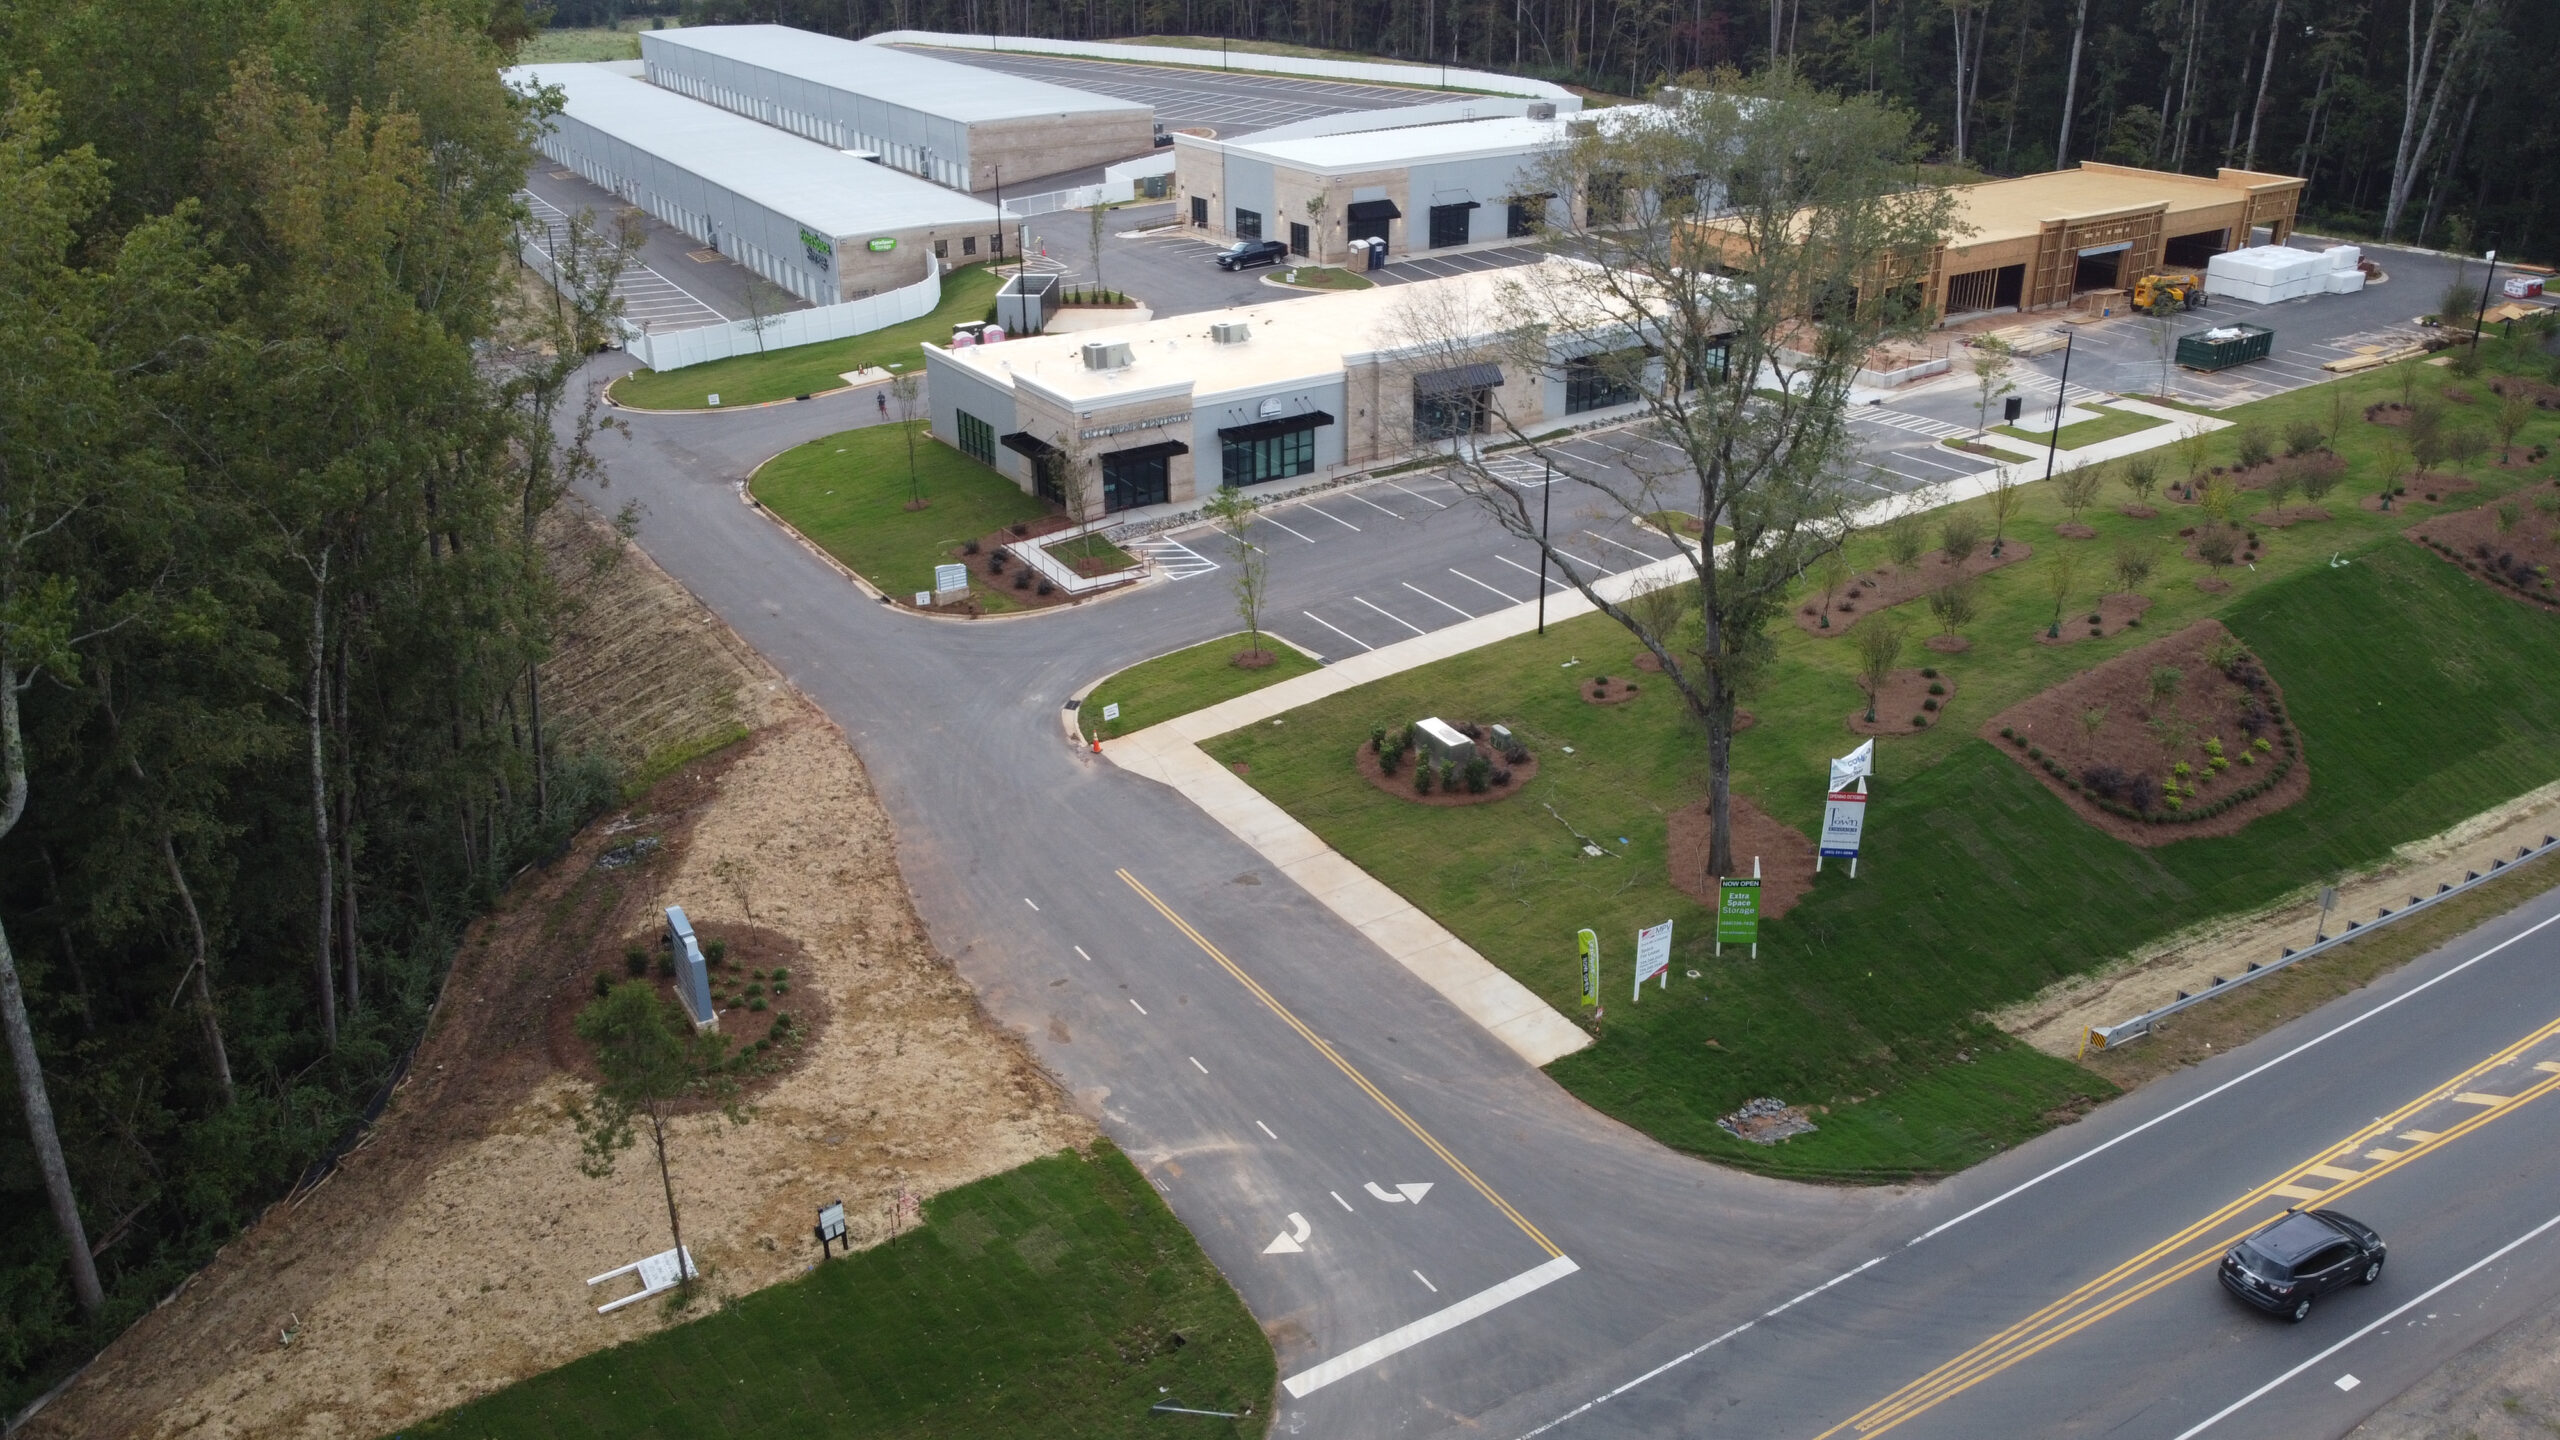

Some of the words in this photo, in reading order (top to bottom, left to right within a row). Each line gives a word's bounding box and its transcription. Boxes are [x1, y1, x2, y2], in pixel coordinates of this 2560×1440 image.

[1729, 892, 1750, 900] Extra
[1727, 899, 1751, 907] Space
[1722, 906, 1755, 915] Storage
[1655, 924, 1670, 934] MPV
